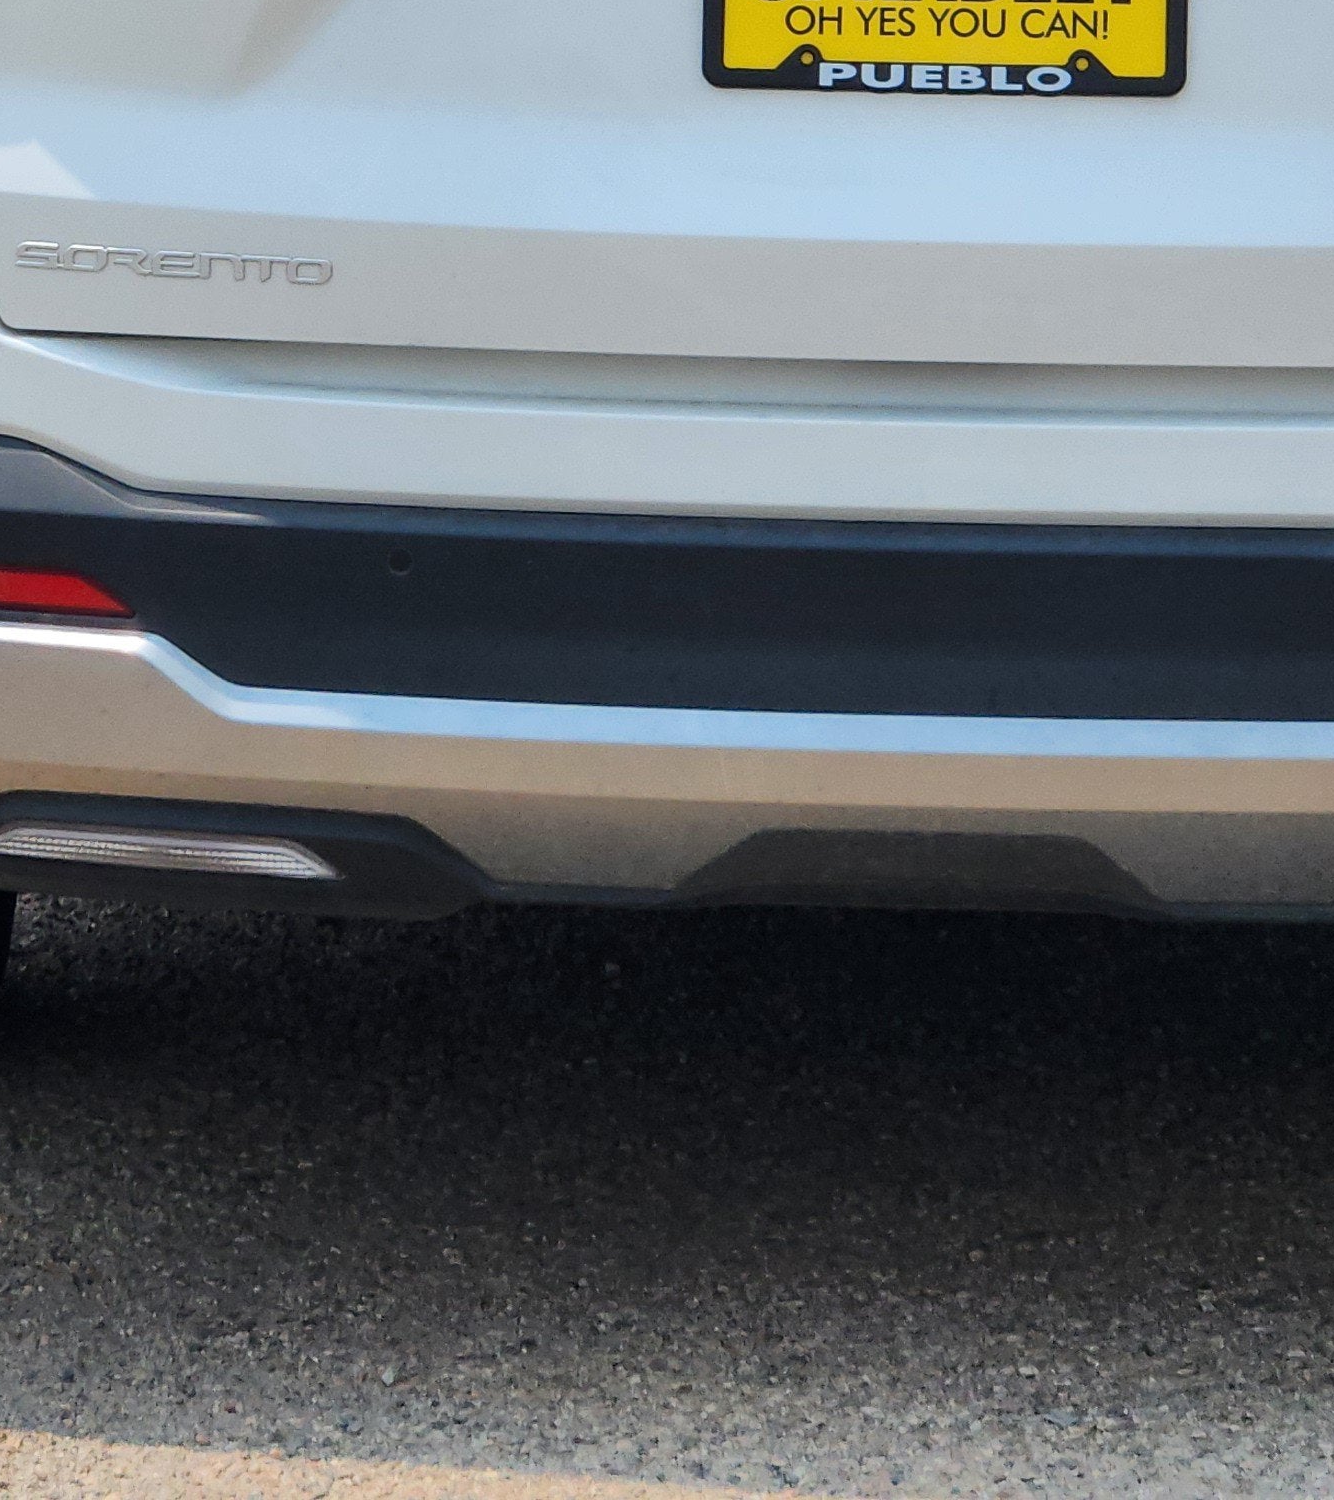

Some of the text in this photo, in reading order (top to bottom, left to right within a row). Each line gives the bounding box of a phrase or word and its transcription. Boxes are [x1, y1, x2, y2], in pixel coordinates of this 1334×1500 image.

[785, 6, 1108, 40] OH YES YOU CAN!
[818, 62, 1073, 92] PUEBLO
[16, 241, 334, 285] SORENTO
